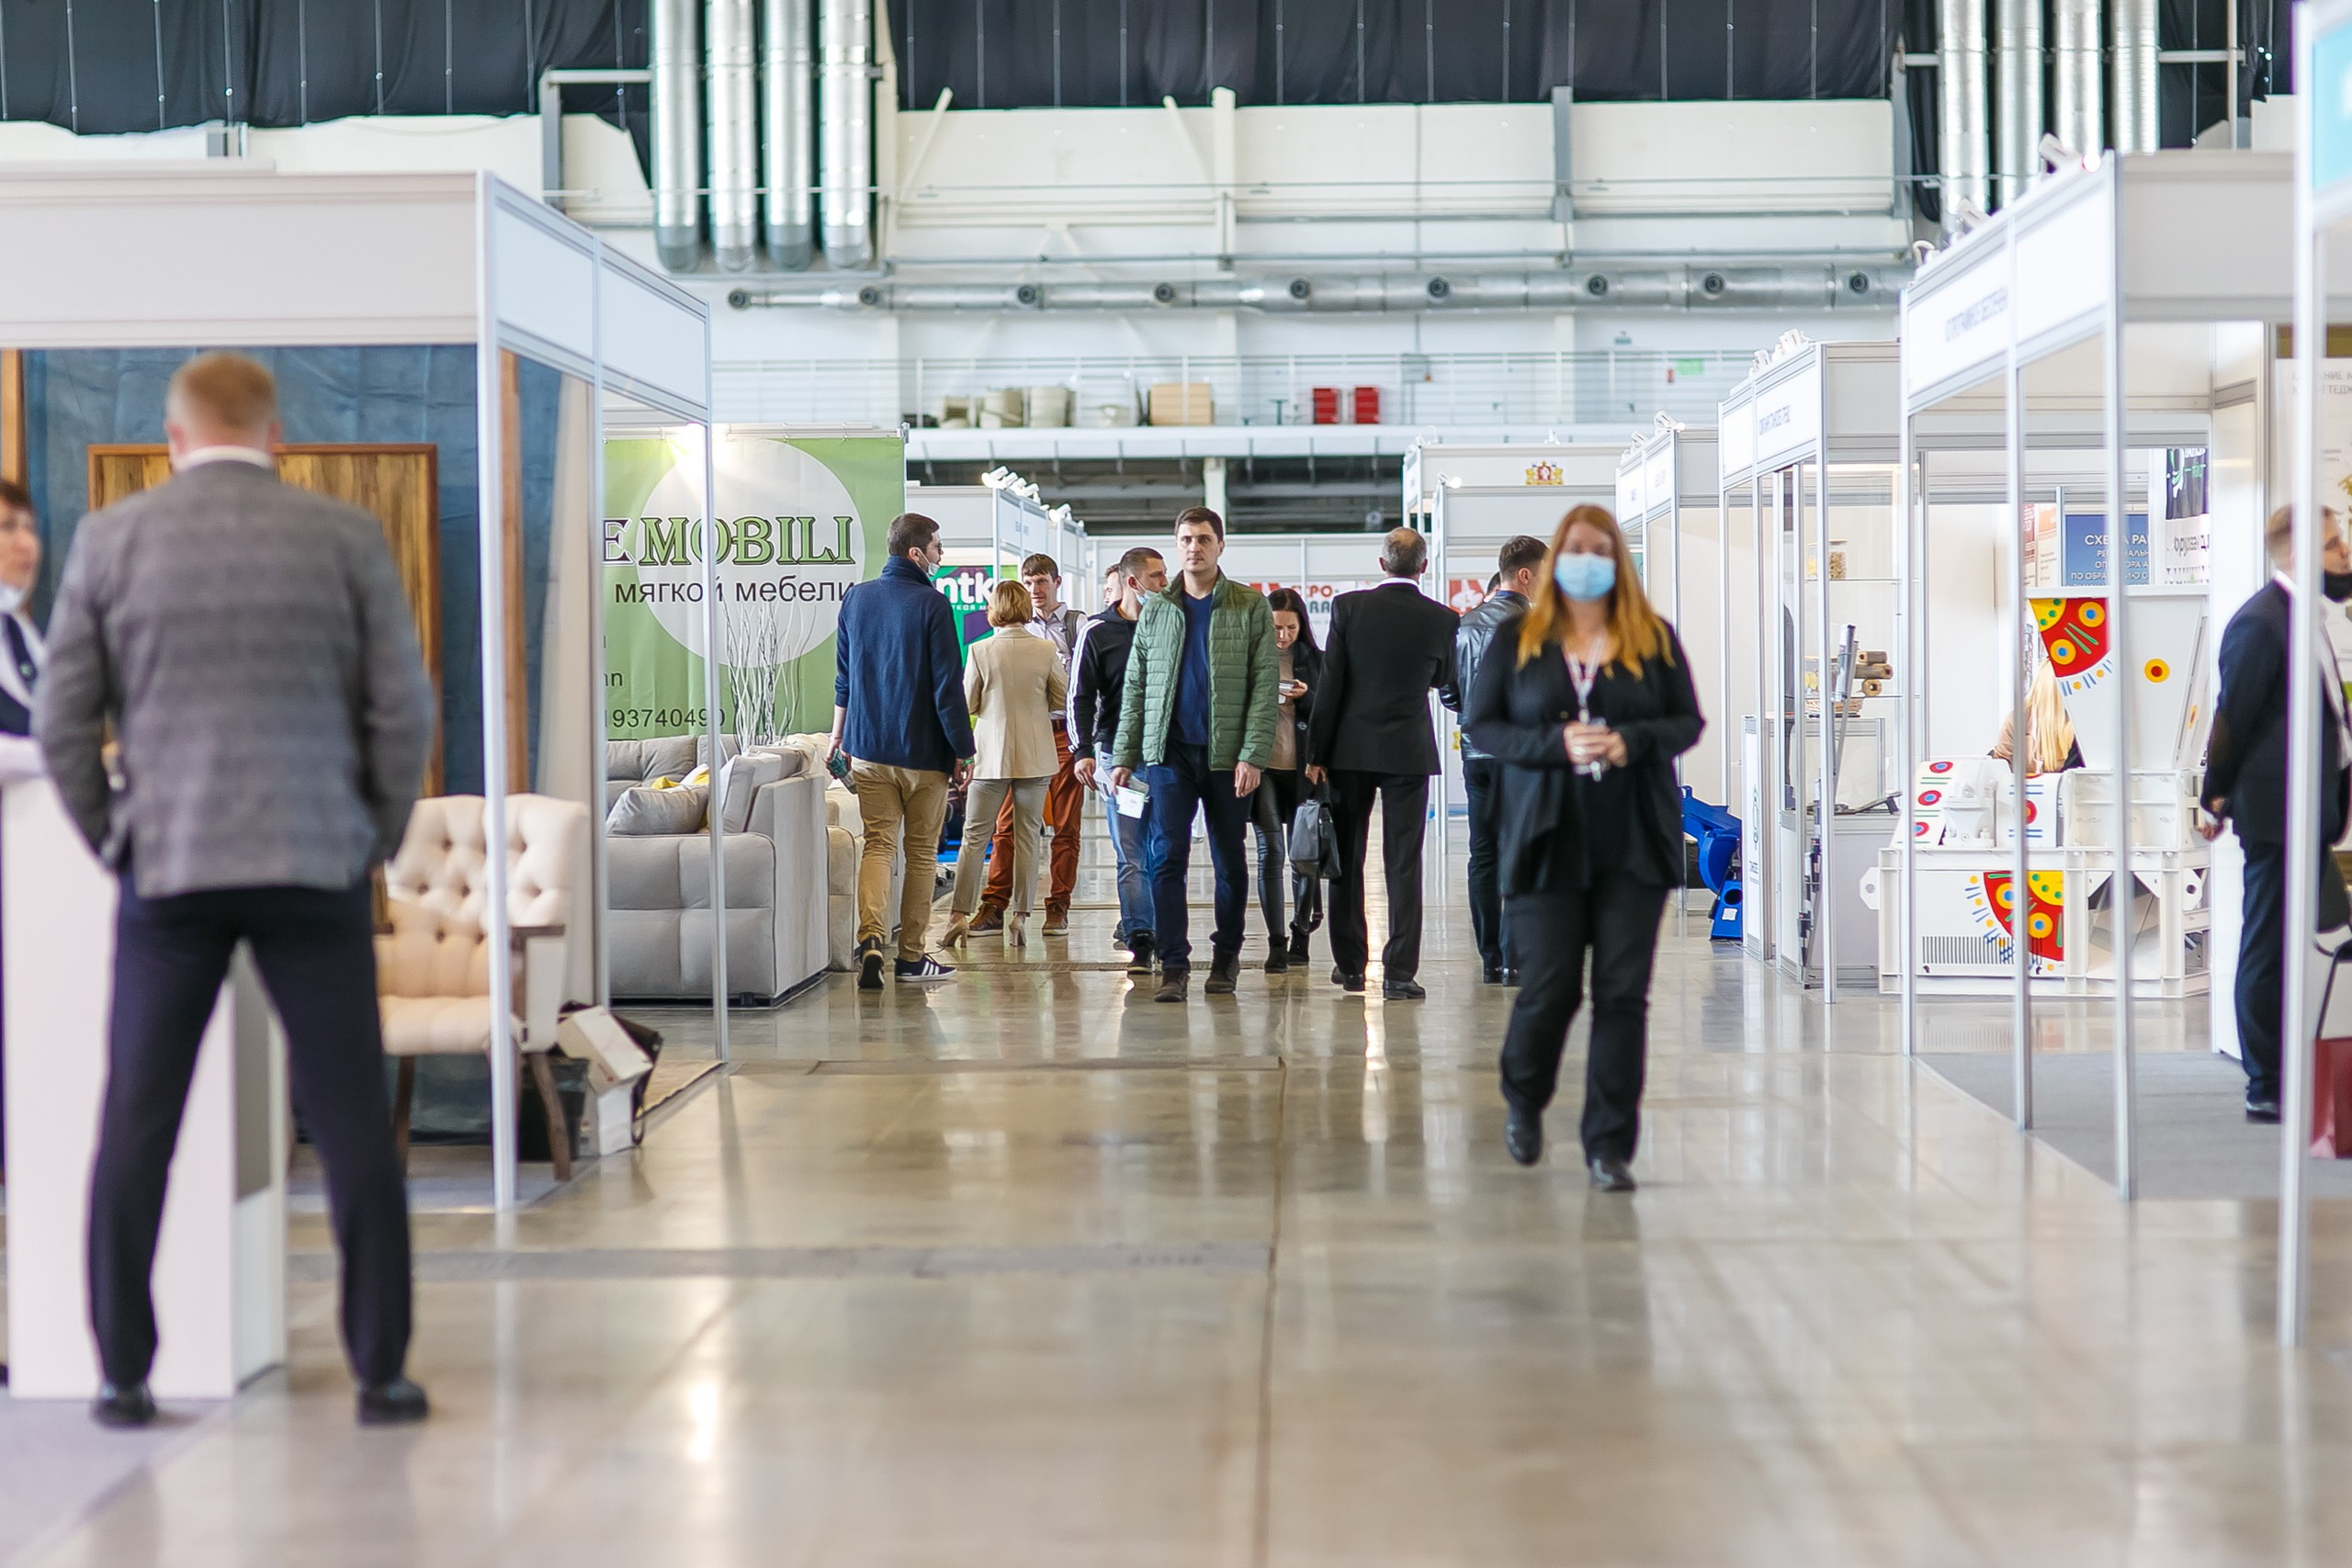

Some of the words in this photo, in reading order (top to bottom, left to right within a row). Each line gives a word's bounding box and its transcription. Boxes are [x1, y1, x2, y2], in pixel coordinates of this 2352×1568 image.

[639, 516, 856, 566] MOBILI
[2084, 535, 2130, 545] СХЕА
[2132, 535, 2149, 545] РА
[2071, 572, 2084, 581] ПО
[615, 575, 723, 604] мягкой
[736, 575, 854, 603] мебели
